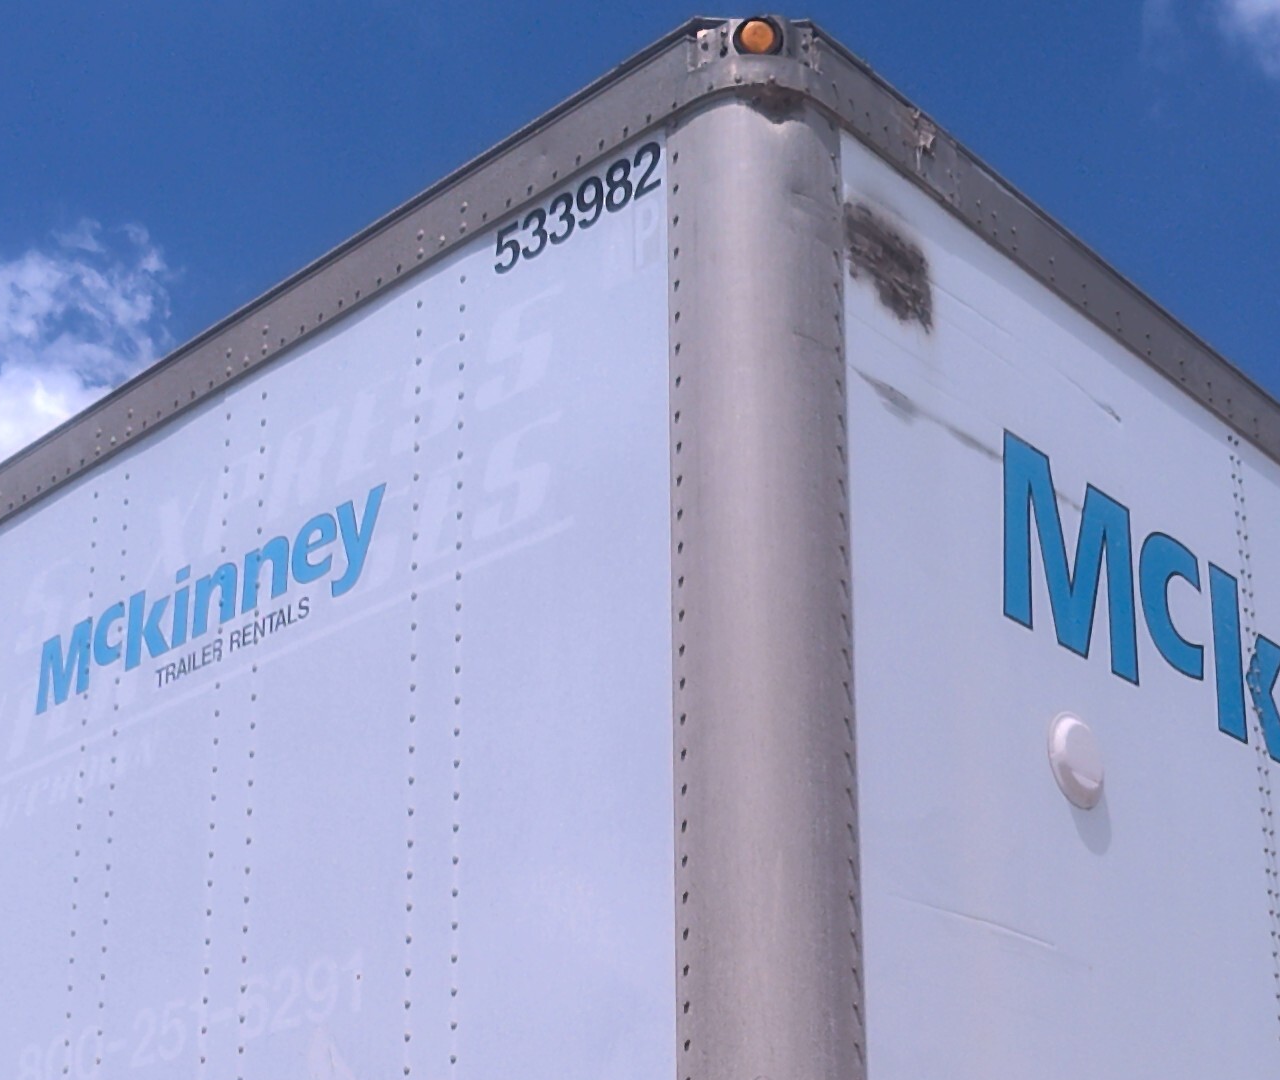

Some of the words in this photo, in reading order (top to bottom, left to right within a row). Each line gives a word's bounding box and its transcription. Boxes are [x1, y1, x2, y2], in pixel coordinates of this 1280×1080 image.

[494, 141, 662, 274] 533982
[155, 636, 224, 688] TRAILER
[229, 597, 311, 653] RENTALS
